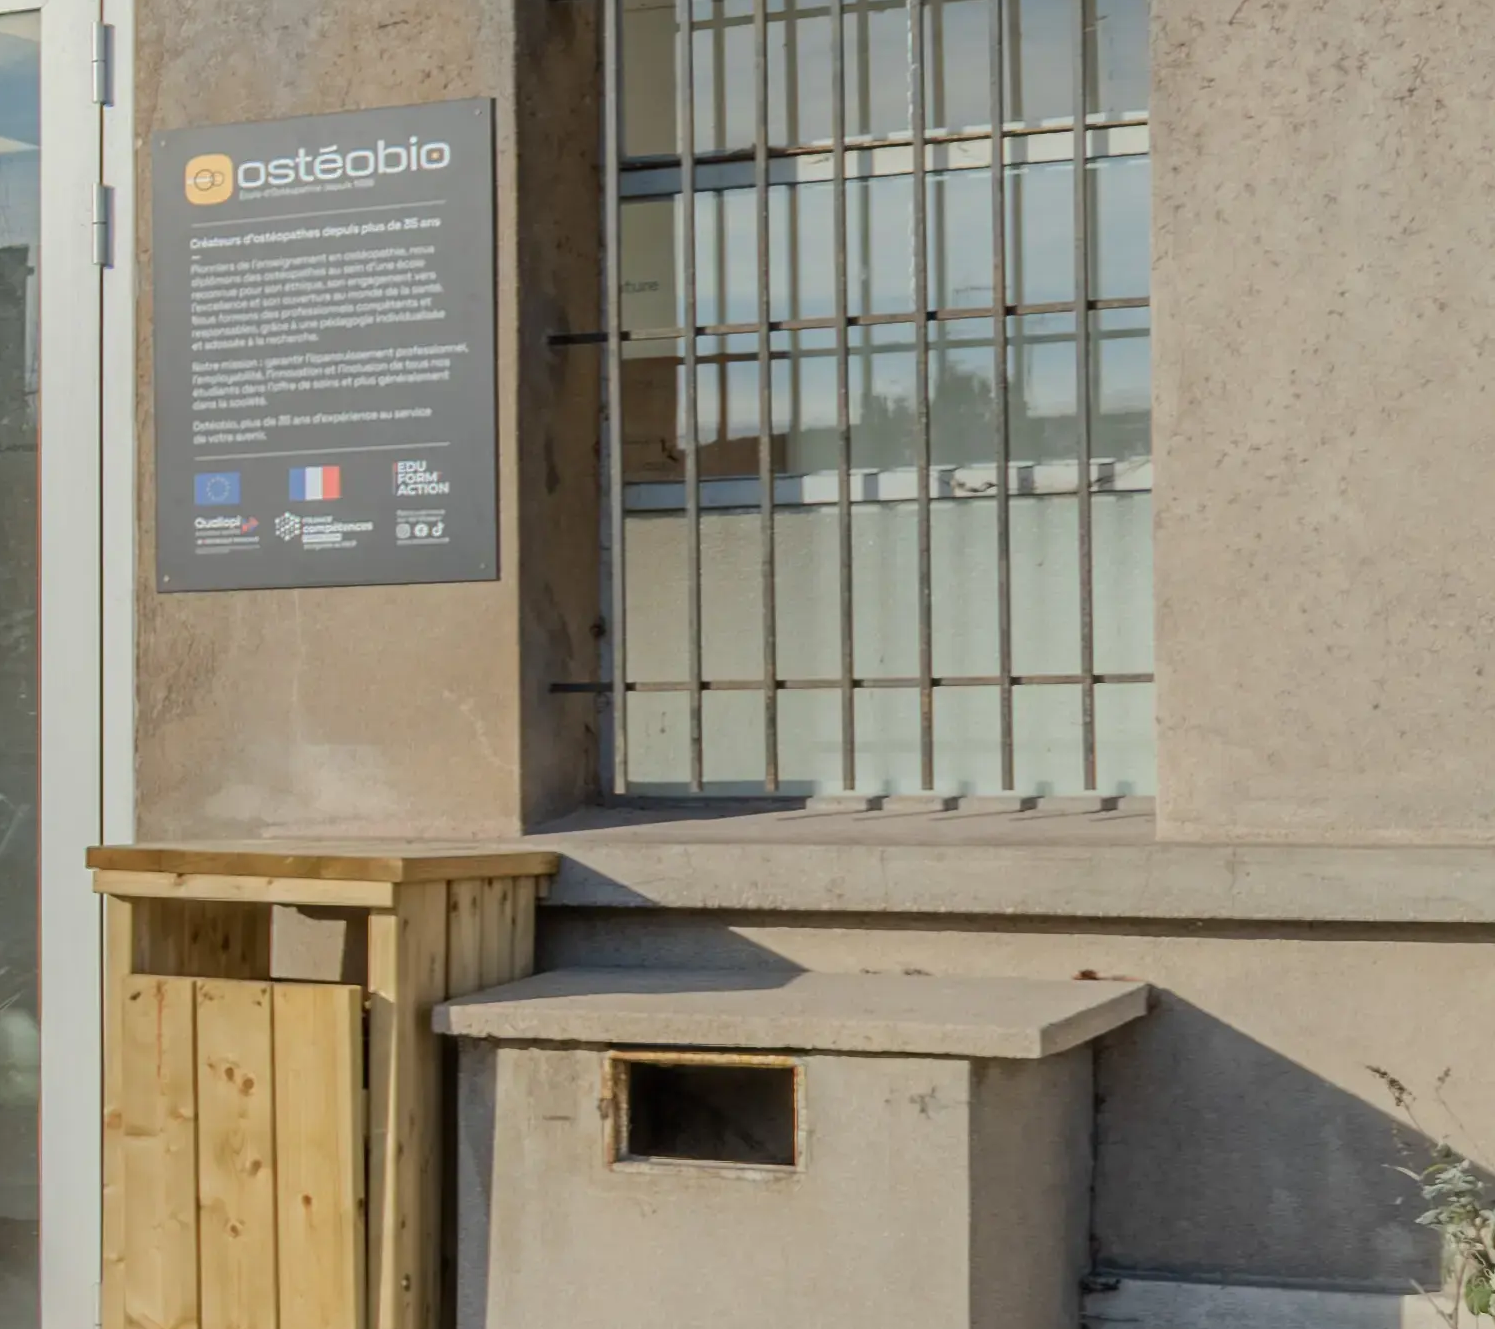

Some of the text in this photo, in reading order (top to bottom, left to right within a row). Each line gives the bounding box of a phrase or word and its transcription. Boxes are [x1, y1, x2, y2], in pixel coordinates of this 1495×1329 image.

[238, 136, 450, 187] ostéobio
[396, 460, 427, 473] EDU
[397, 471, 438, 485] FORM
[396, 481, 450, 496] ACTION
